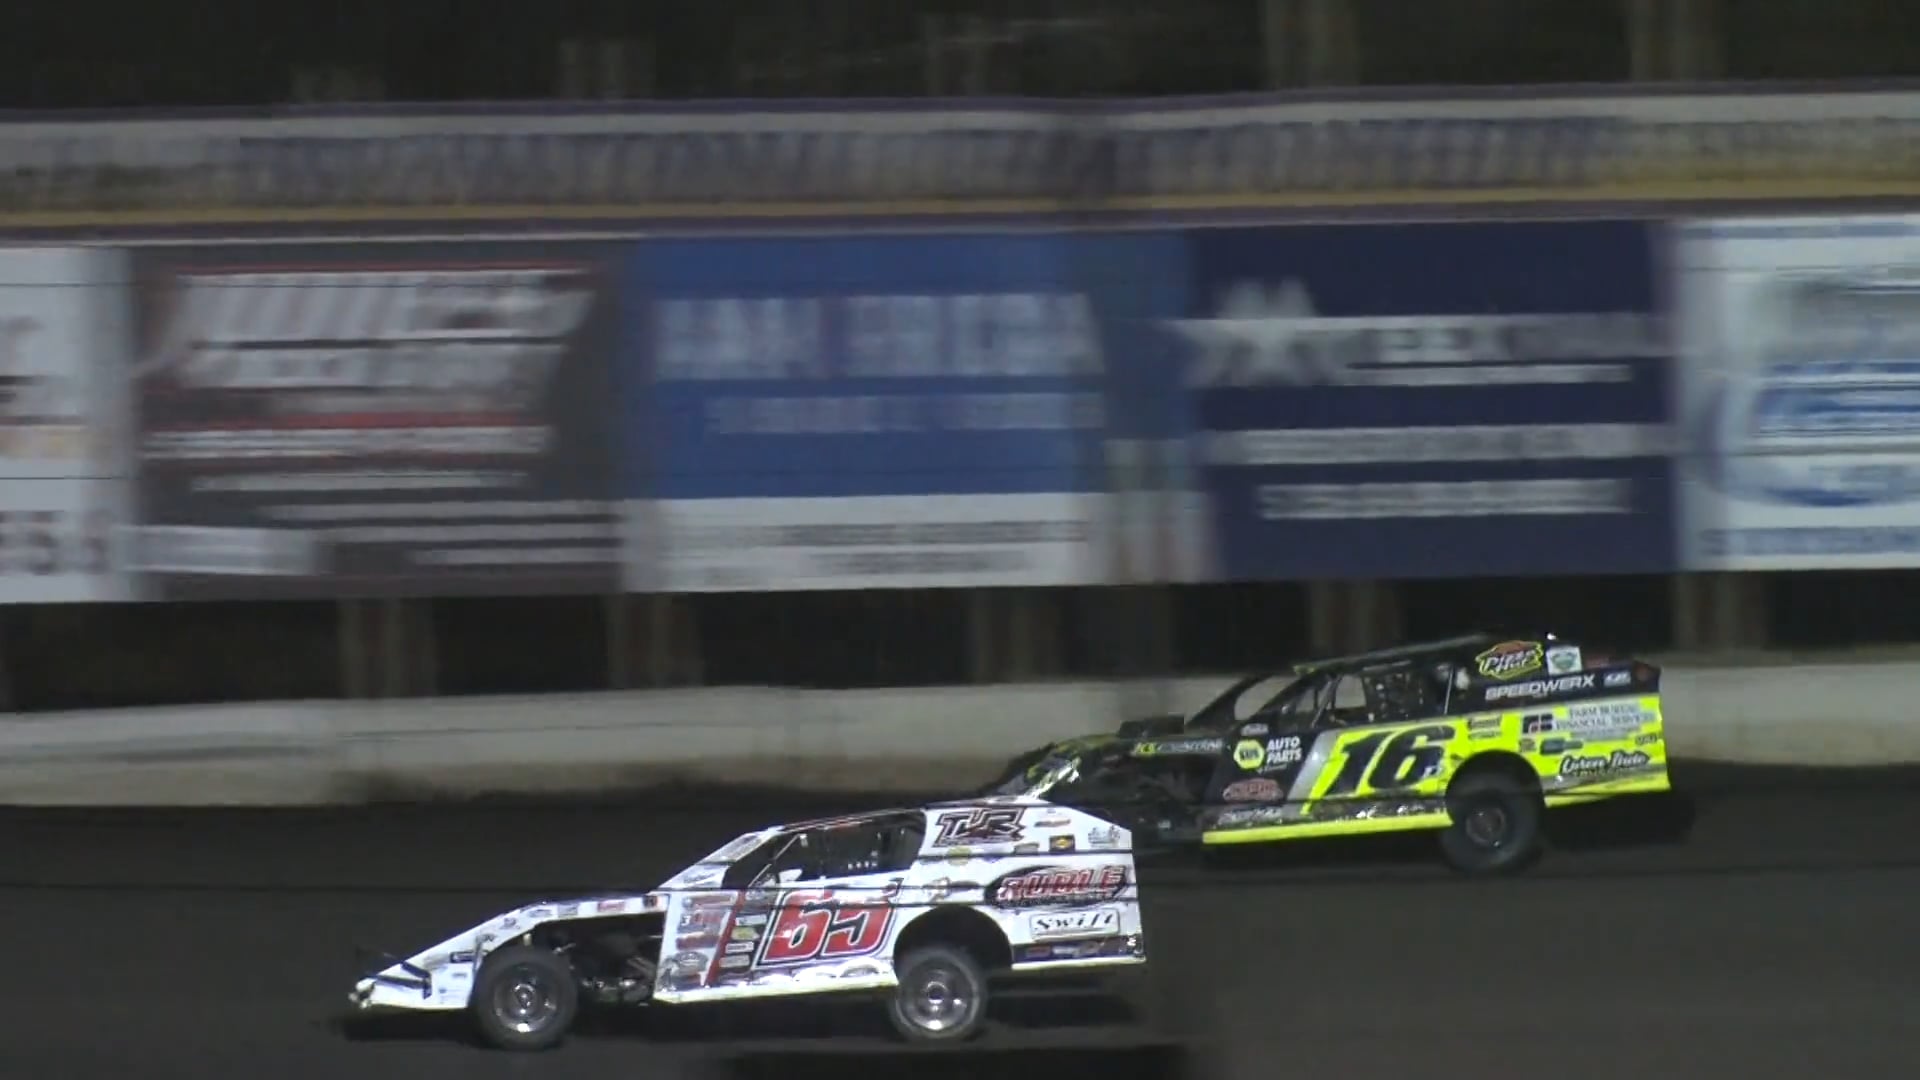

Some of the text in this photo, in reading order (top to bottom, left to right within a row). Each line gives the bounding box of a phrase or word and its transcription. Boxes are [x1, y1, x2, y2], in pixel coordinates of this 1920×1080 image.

[1485, 674, 1596, 700] SPEEDWERX
[1267, 736, 1301, 751] AUTO
[1266, 748, 1303, 764] PARTS
[1324, 724, 1456, 794] 16
[762, 878, 904, 964] 65
[1035, 912, 1114, 931] Swift
